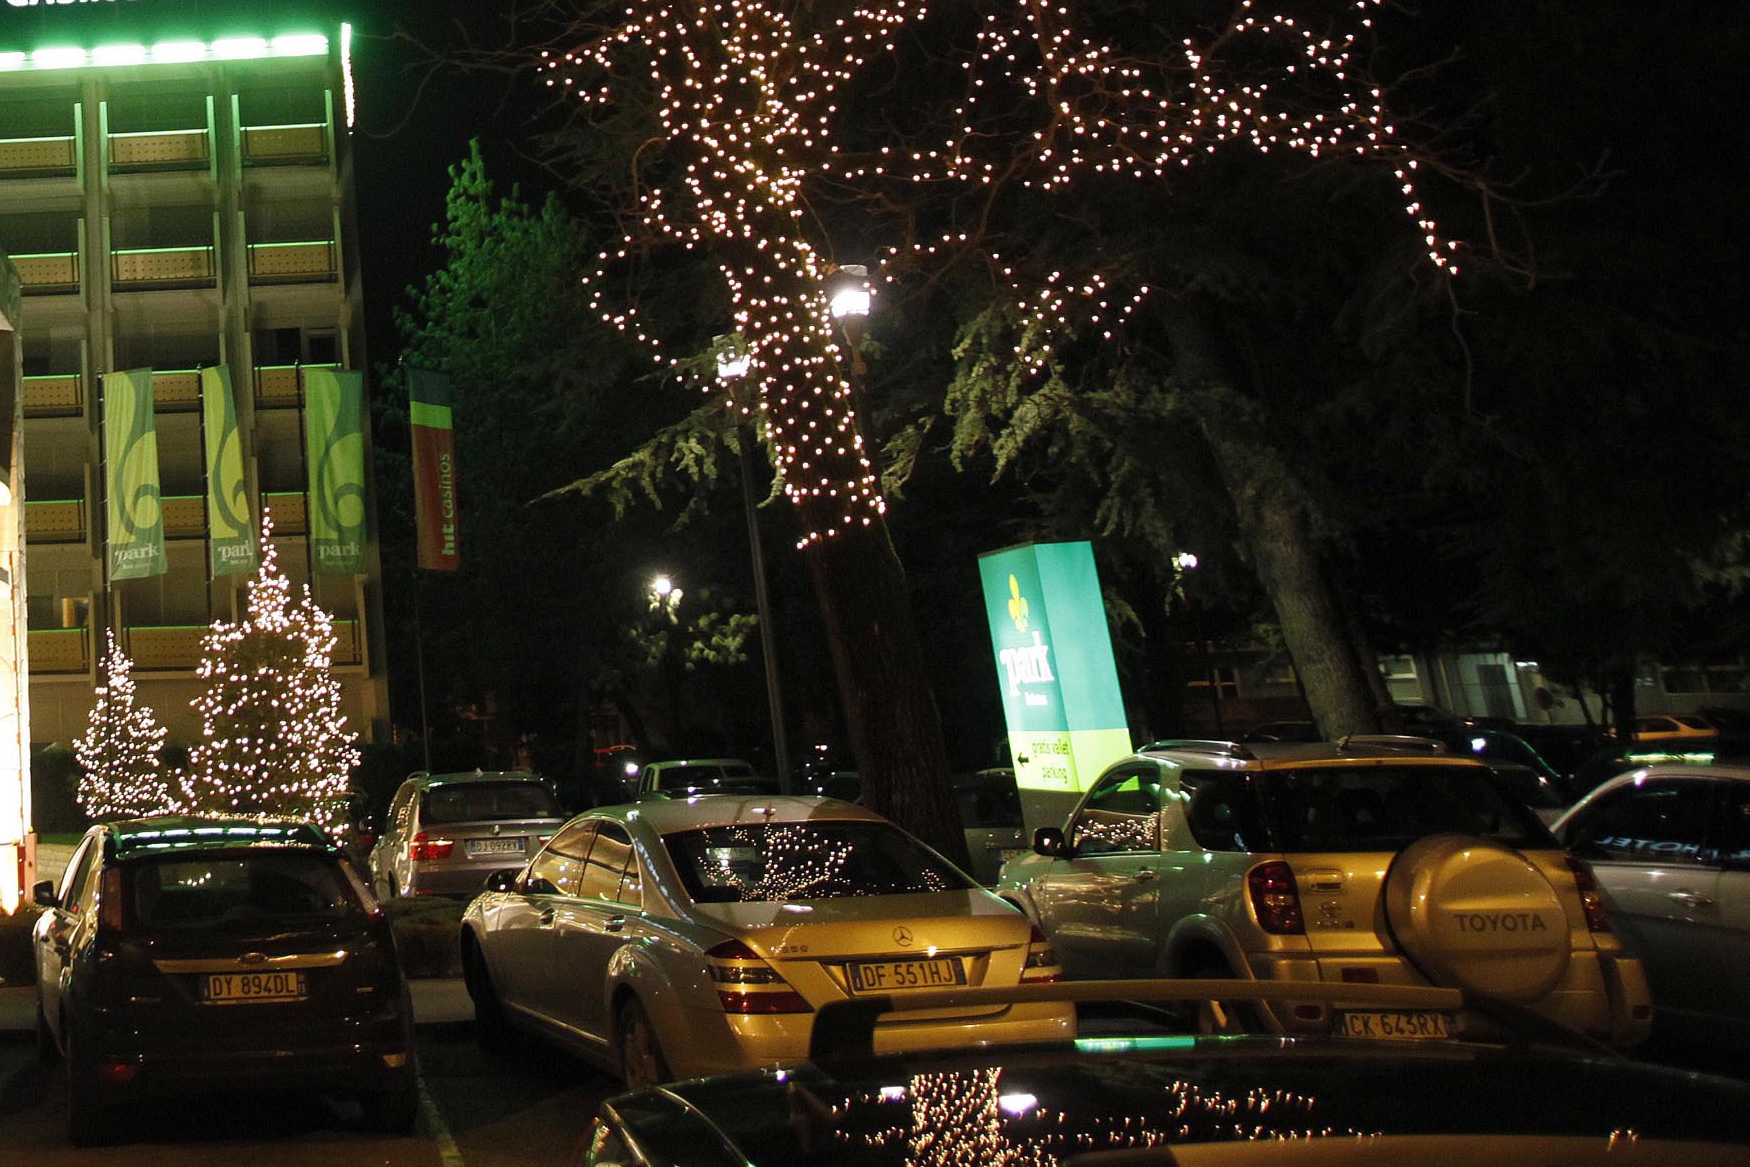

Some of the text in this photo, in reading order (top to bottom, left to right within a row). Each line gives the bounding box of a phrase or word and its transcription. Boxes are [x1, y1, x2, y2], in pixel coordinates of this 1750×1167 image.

[441, 453, 454, 519] casinos
[114, 542, 162, 564] park
[317, 541, 362, 559] park
[999, 631, 1054, 698] park
[1453, 913, 1547, 932] TOYOTA
[212, 975, 234, 997] DY
[240, 973, 297, 995] 894DL
[862, 960, 952, 988] DF 551HJ
[1349, 1015, 1377, 1035] CK
